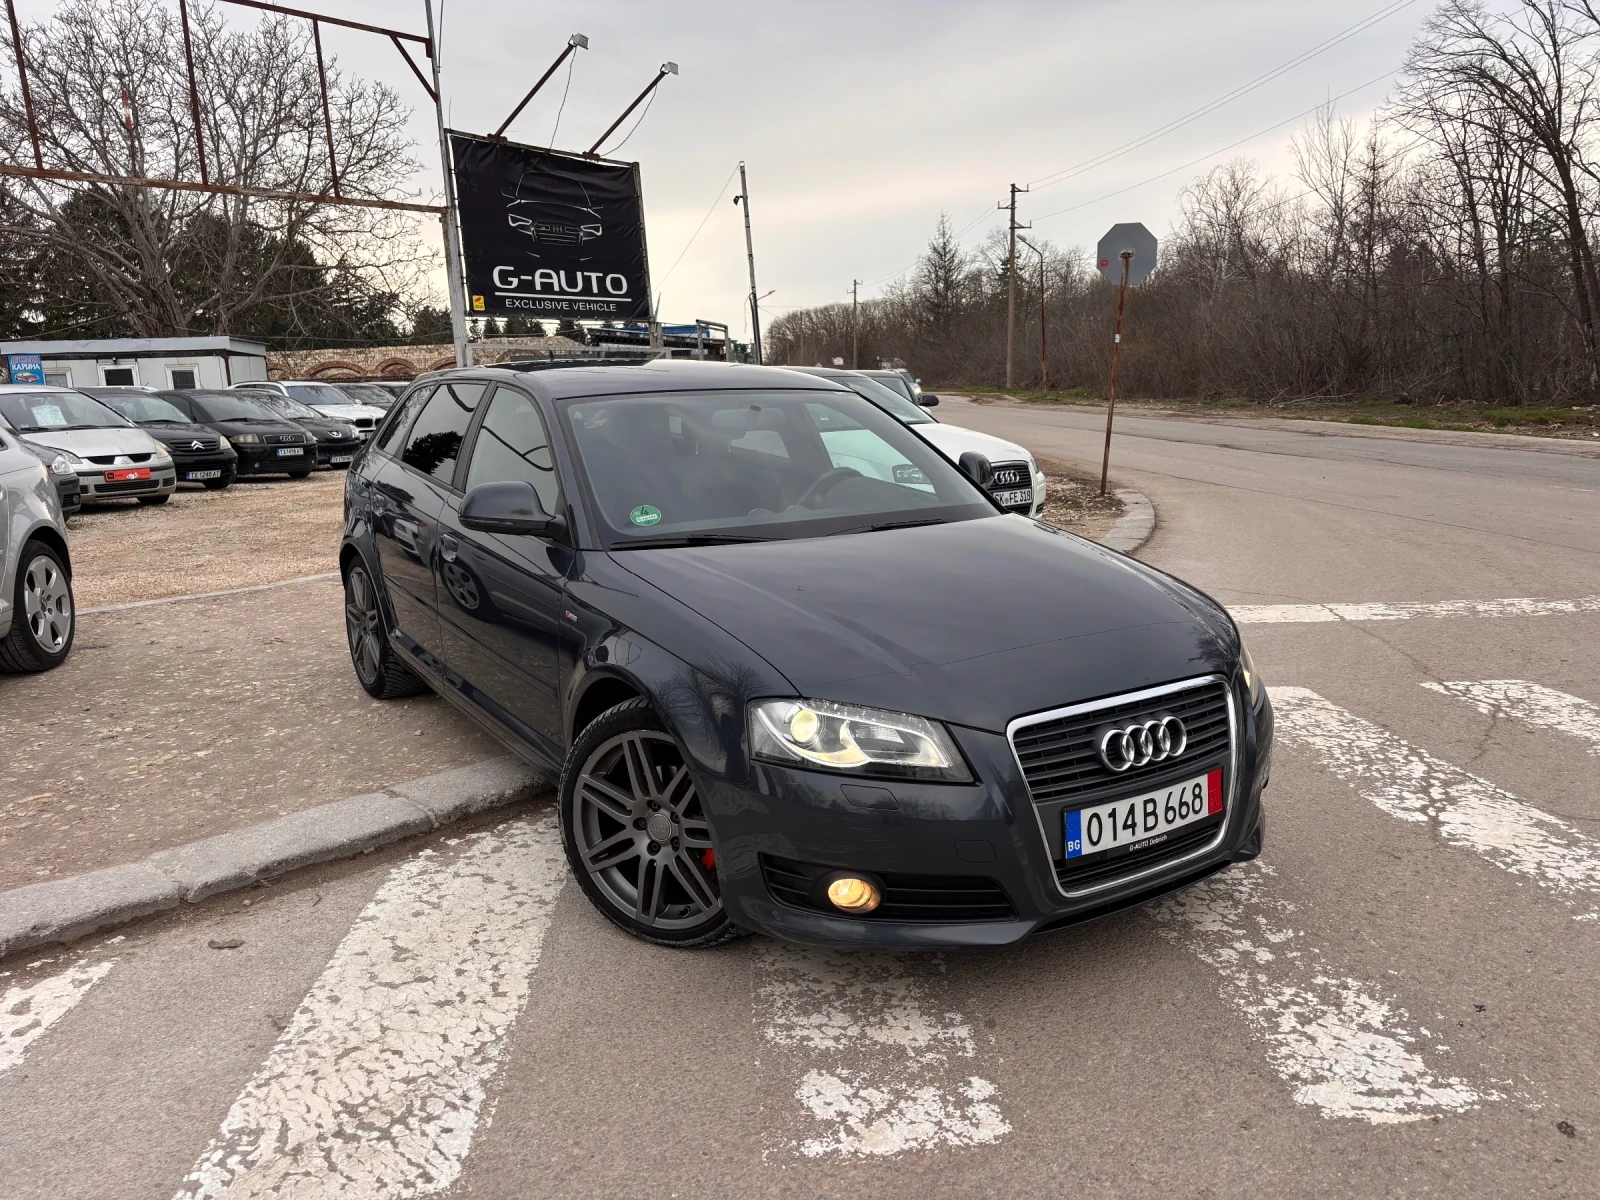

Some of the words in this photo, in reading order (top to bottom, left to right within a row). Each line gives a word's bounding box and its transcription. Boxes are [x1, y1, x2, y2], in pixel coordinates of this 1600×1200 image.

[492, 265, 628, 295] G-AUTO
[505, 298, 570, 310] EXCLUSIVE
[572, 301, 617, 312] VEHICLE
[1009, 491, 1019, 504] FE
[1019, 489, 1031, 502] 318
[1067, 838, 1081, 852] BG
